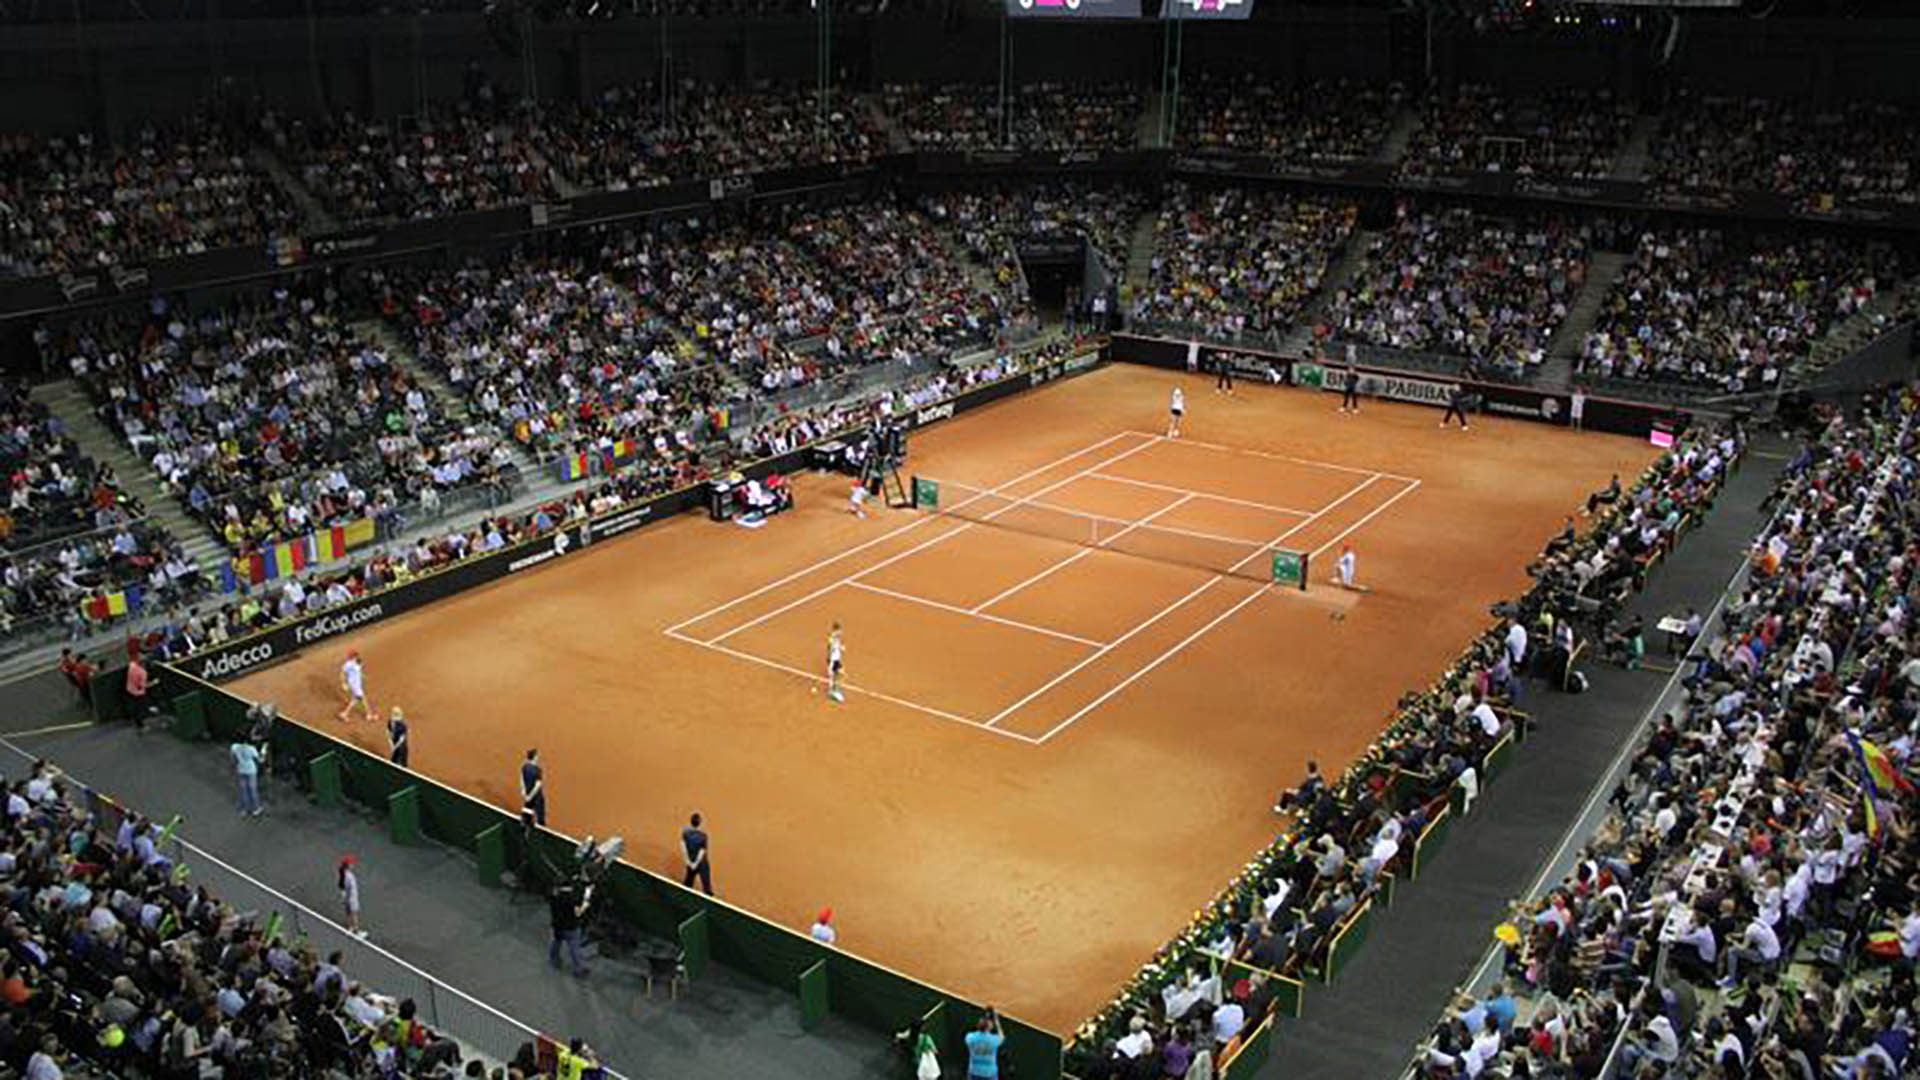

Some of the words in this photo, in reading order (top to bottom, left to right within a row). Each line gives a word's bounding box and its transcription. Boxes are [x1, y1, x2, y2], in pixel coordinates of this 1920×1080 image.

[1385, 379, 1452, 402] PARIBA
[296, 603, 383, 643] FedCup.com
[202, 643, 272, 679] Adecco
